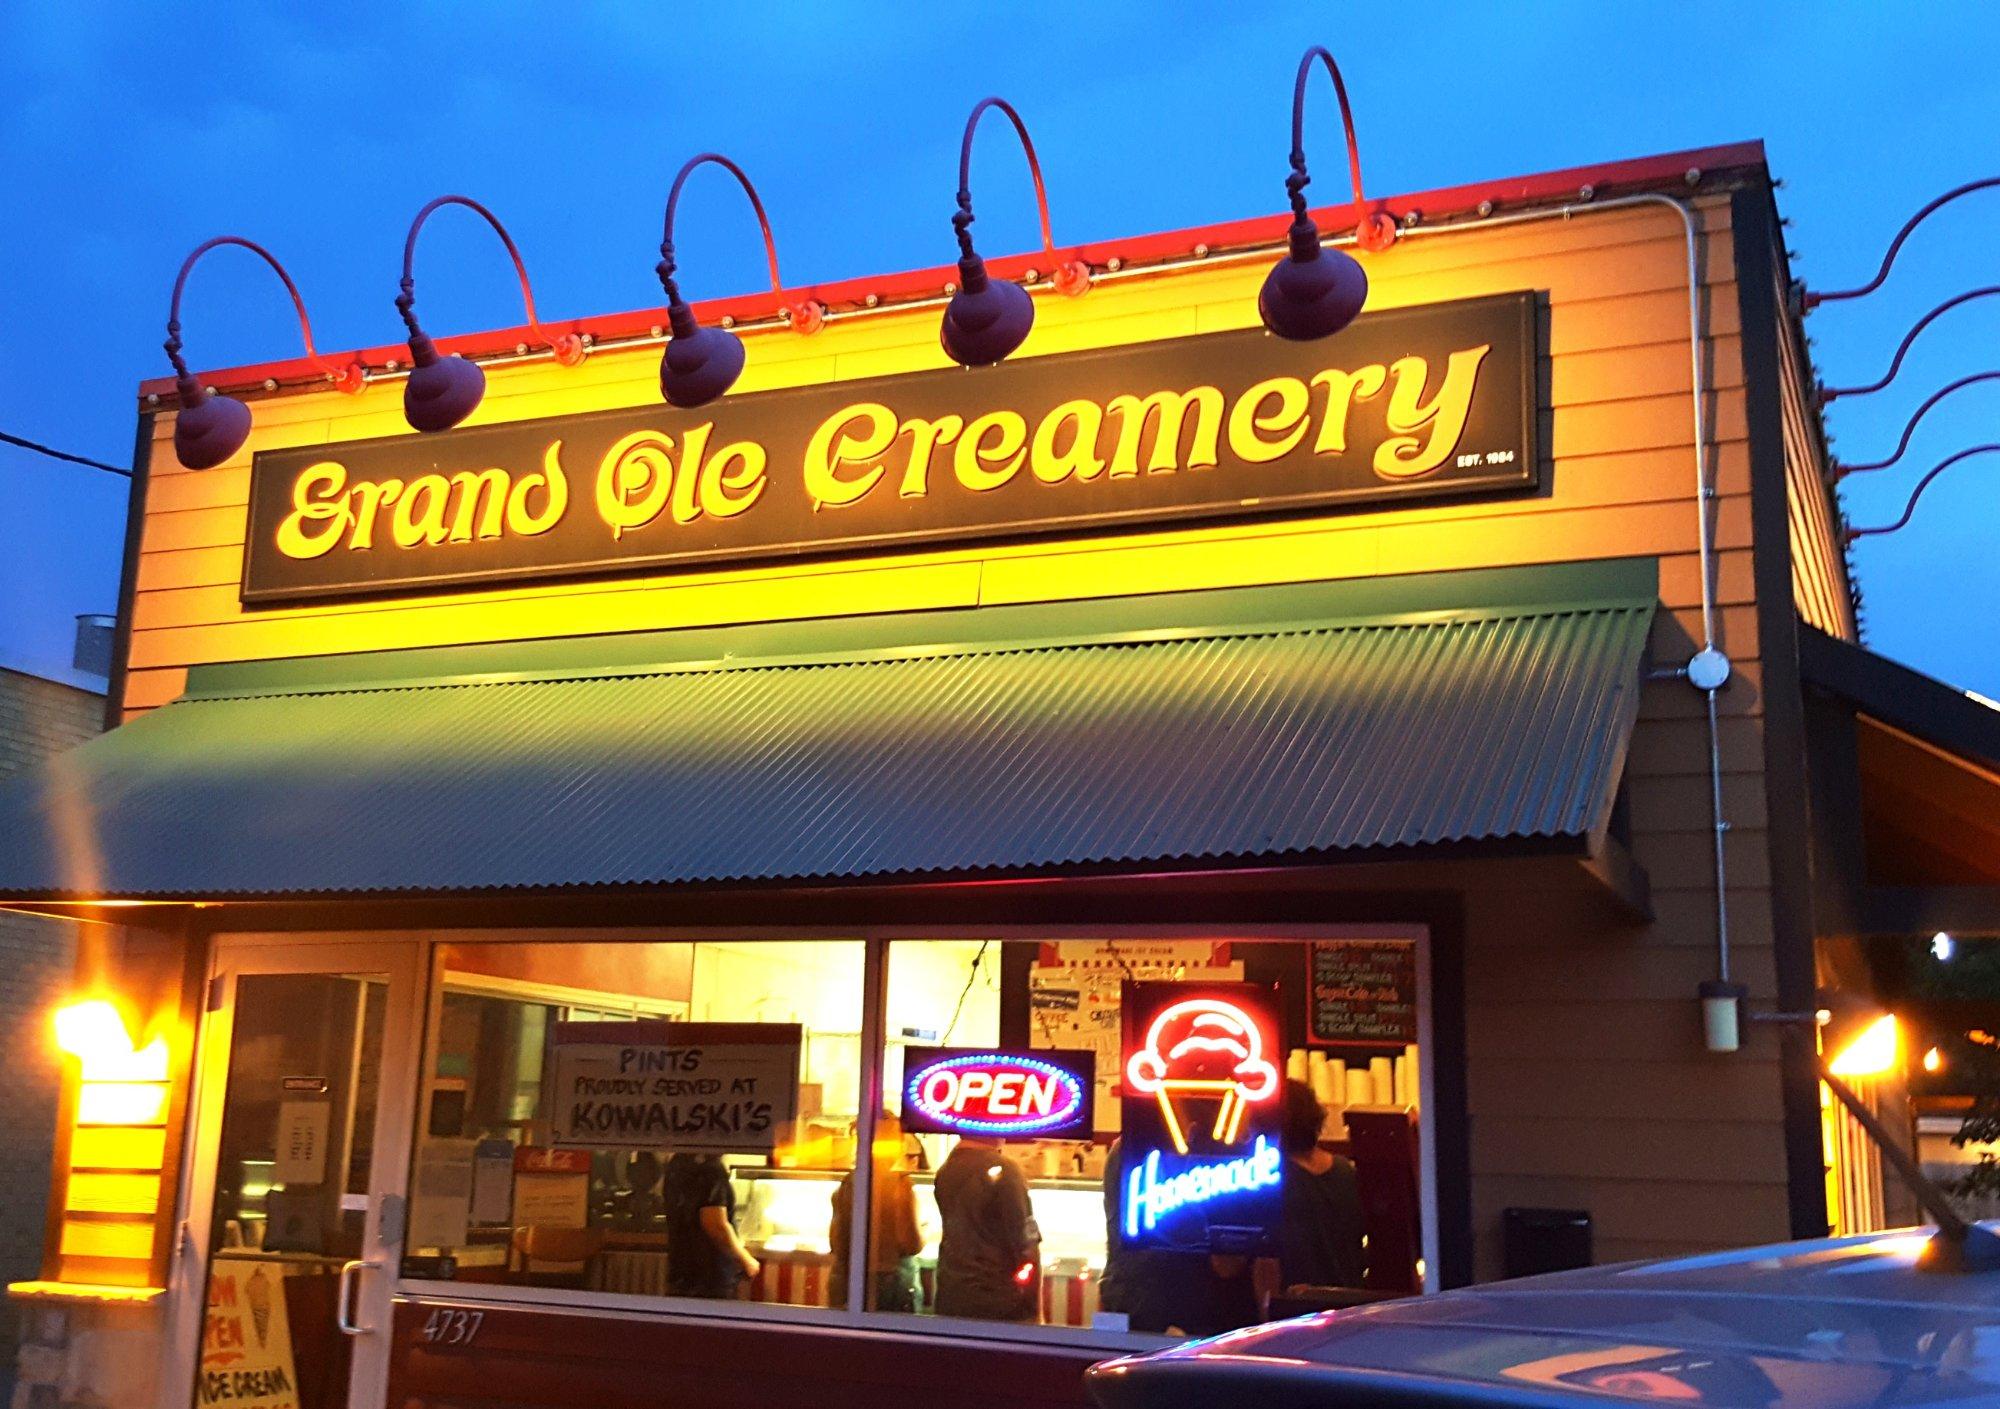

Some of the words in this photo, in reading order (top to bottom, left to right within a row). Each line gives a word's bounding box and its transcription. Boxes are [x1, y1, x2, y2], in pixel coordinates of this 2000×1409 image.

[277, 440, 568, 559] Grand
[597, 422, 767, 541] Ole
[803, 344, 1491, 512] Creamery
[1457, 453, 1482, 468] EST.
[620, 1049, 702, 1074] PINTS
[575, 1076, 646, 1096] PROUDLY
[652, 1078, 721, 1097] SERVED
[730, 1078, 757, 1093] AT
[923, 1072, 1057, 1115] OPEN
[570, 1102, 772, 1133] KOWALSKI'S
[1127, 1134, 1281, 1237] Homemade
[424, 1309, 484, 1343] 4737
[234, 1365, 292, 1399] CREAM
